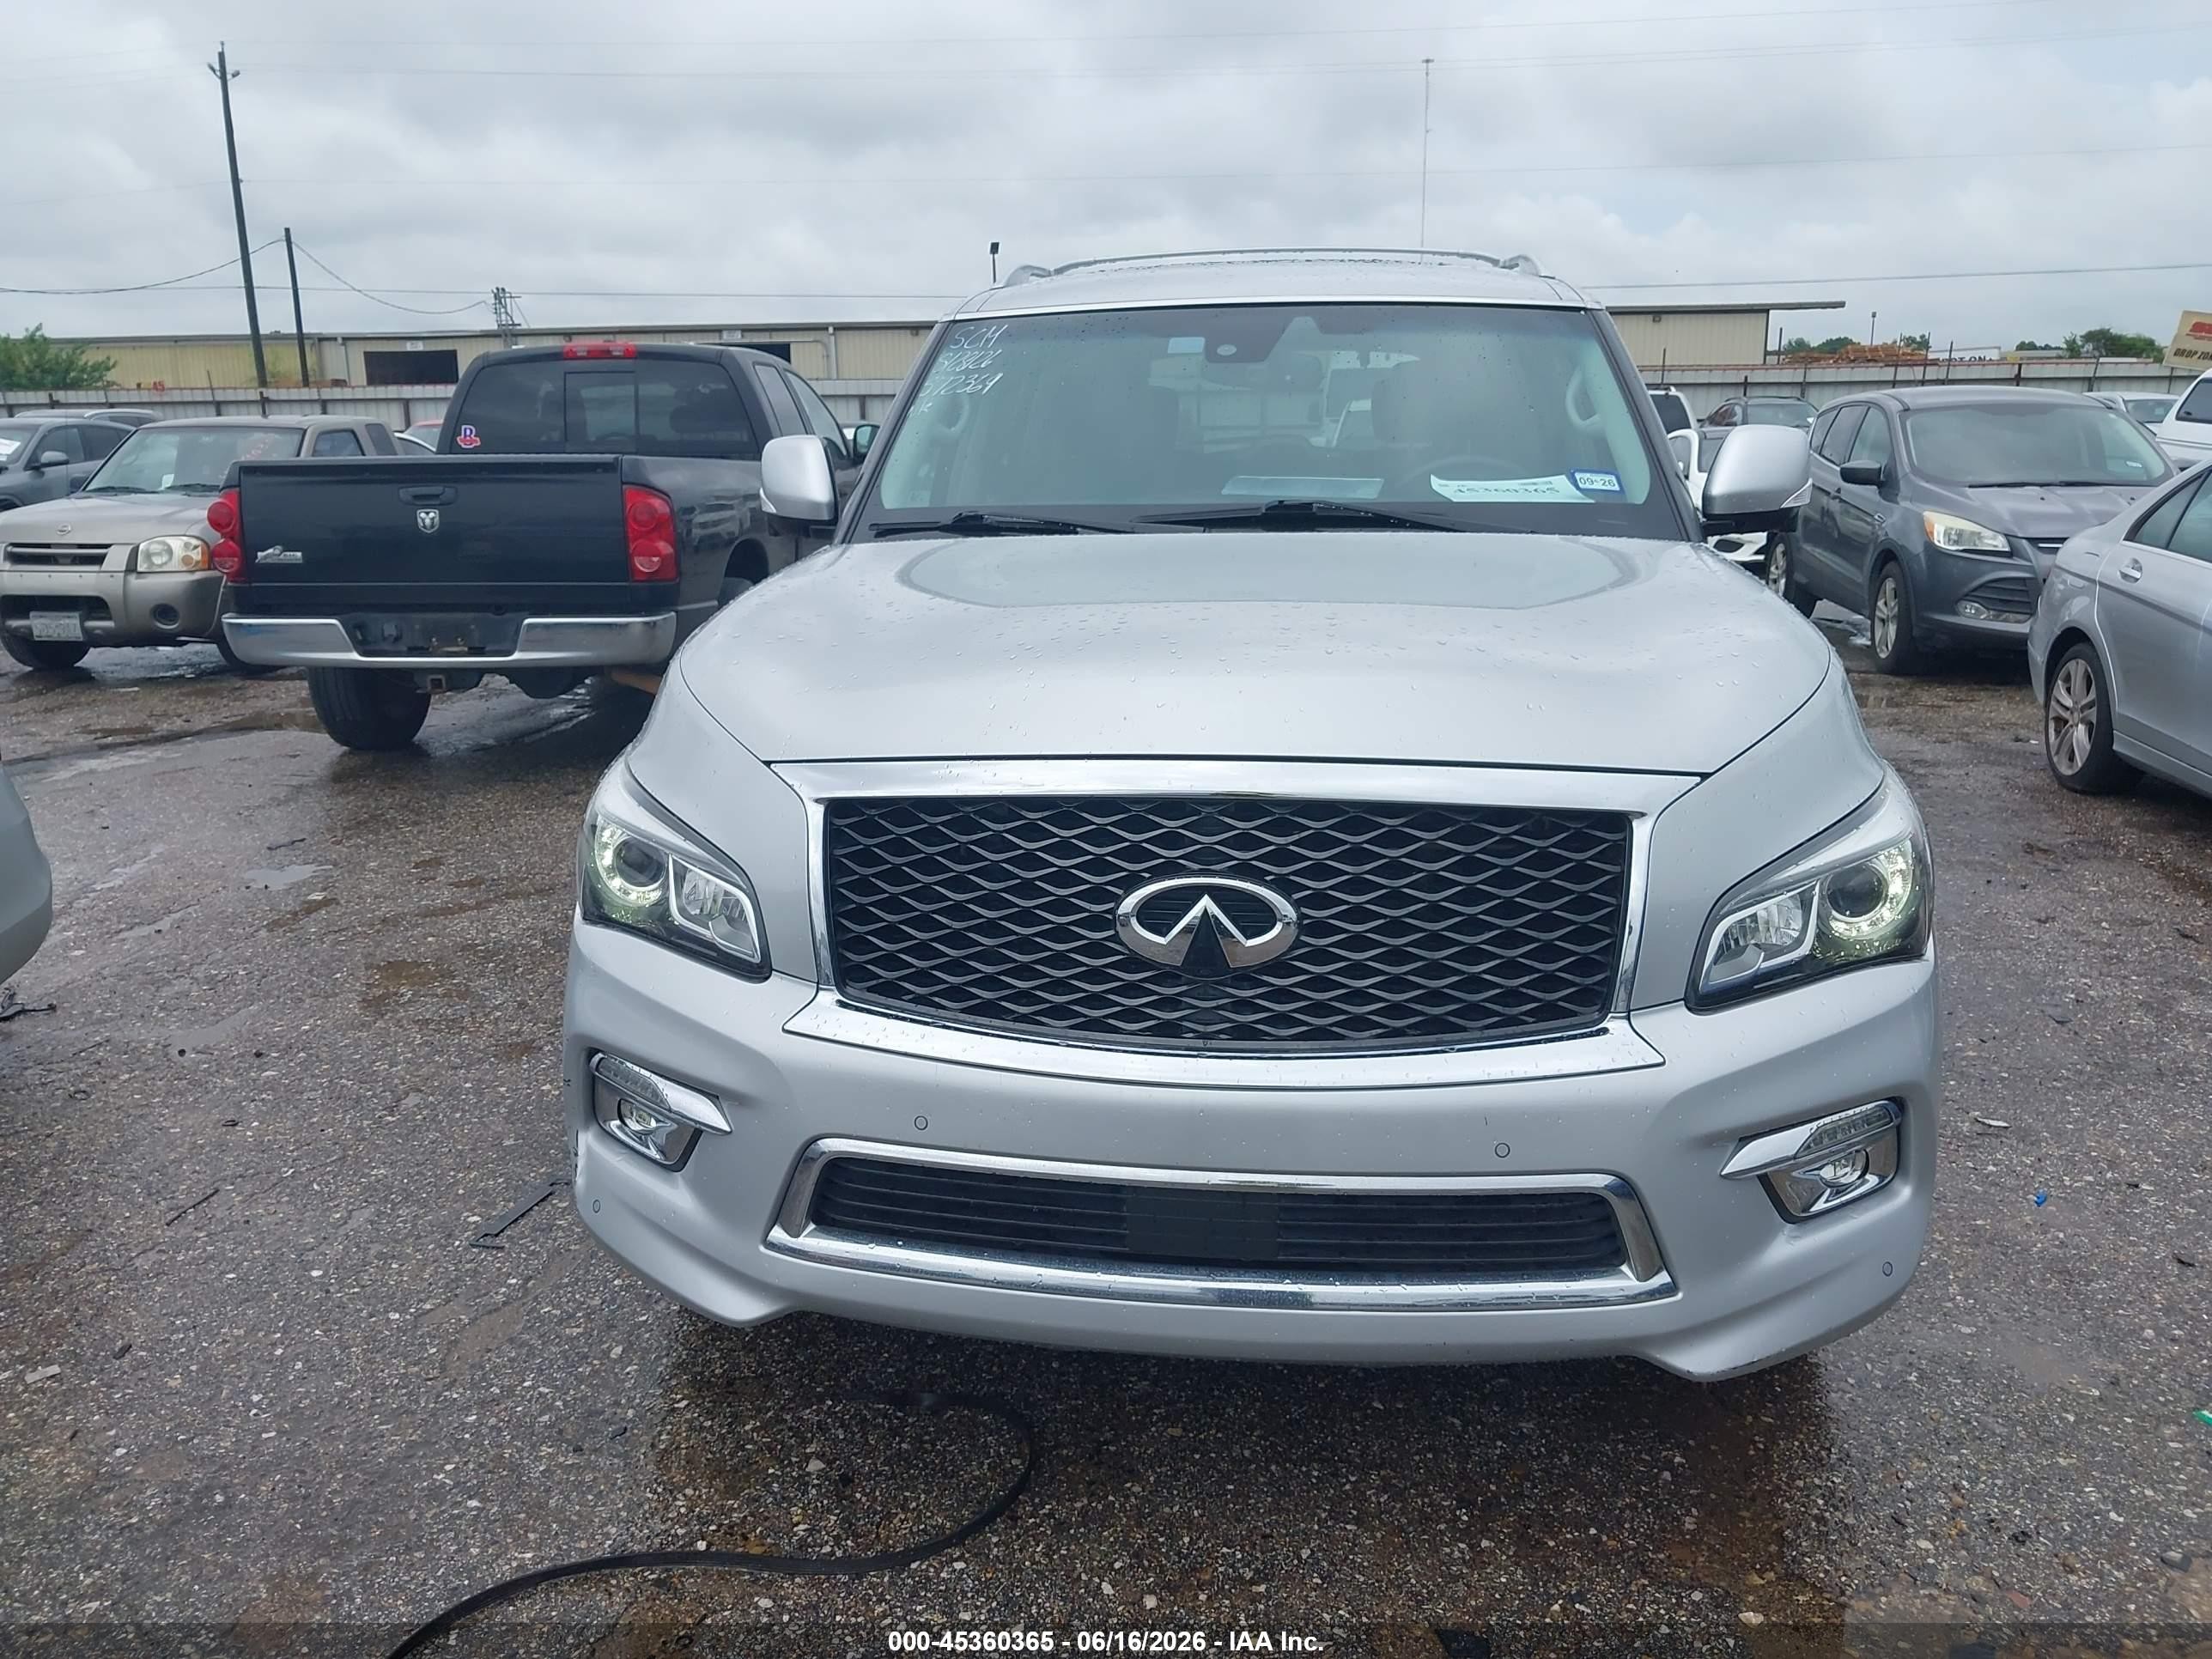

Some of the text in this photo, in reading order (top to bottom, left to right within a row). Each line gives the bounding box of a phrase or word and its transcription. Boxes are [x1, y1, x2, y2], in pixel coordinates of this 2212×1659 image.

[950, 325, 1009, 349] SCM
[2173, 348, 2212, 361] DROP ZO
